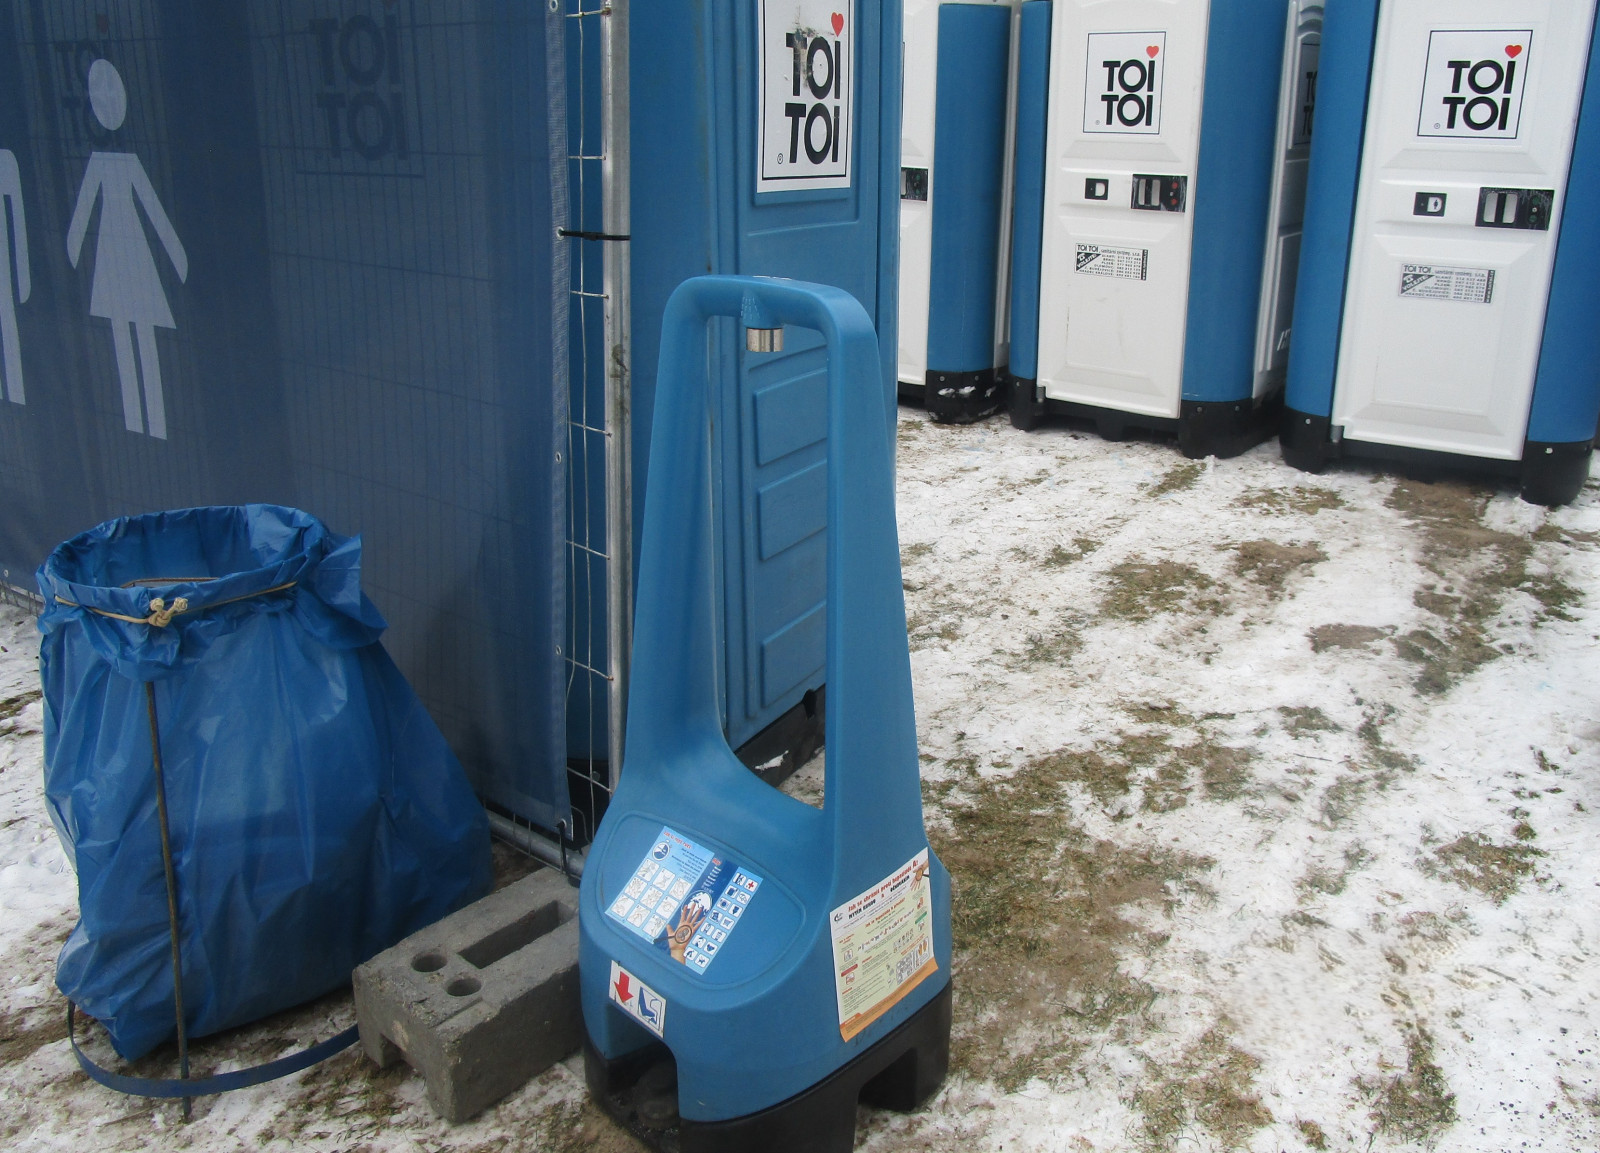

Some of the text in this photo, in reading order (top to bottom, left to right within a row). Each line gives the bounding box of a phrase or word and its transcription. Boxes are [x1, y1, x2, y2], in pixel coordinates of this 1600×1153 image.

[785, 33, 841, 100] TOI
[1102, 59, 1155, 93] TOI
[1447, 59, 1516, 95] TOI
[1101, 94, 1154, 126] TOI
[1442, 96, 1510, 131] TOI
[785, 103, 840, 164] TOI
